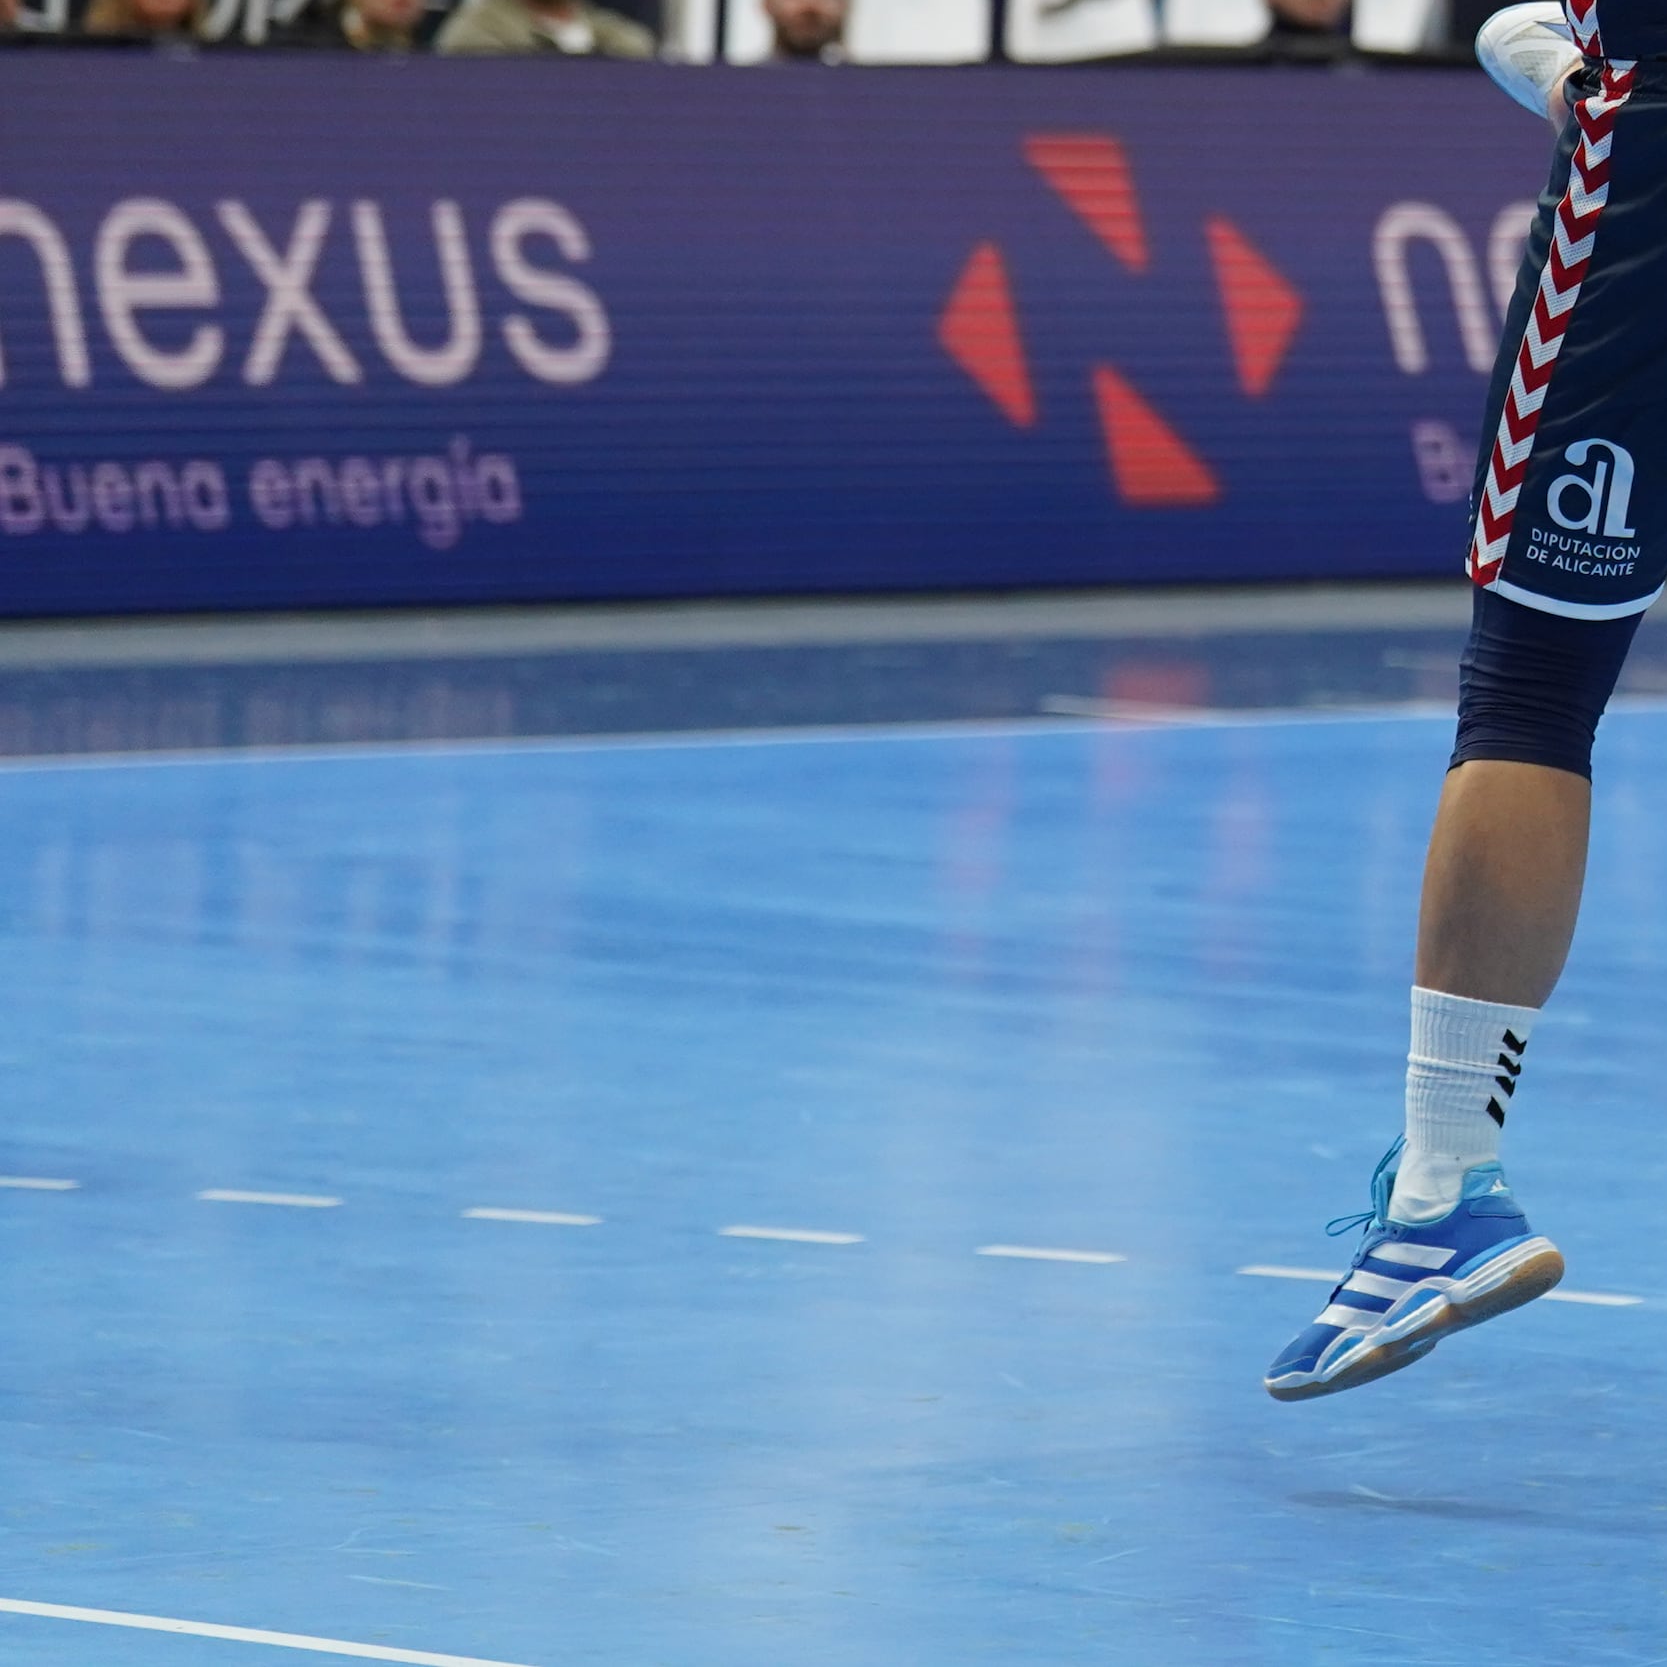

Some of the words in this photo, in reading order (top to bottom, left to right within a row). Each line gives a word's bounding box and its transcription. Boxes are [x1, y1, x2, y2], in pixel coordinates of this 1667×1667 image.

[0, 198, 611, 390] nexus
[0, 444, 230, 532] Buena
[1526, 545, 1549, 564] DE
[1551, 554, 1636, 577] ALICANTE
[1531, 527, 1641, 561] DIPUTACIÓN
